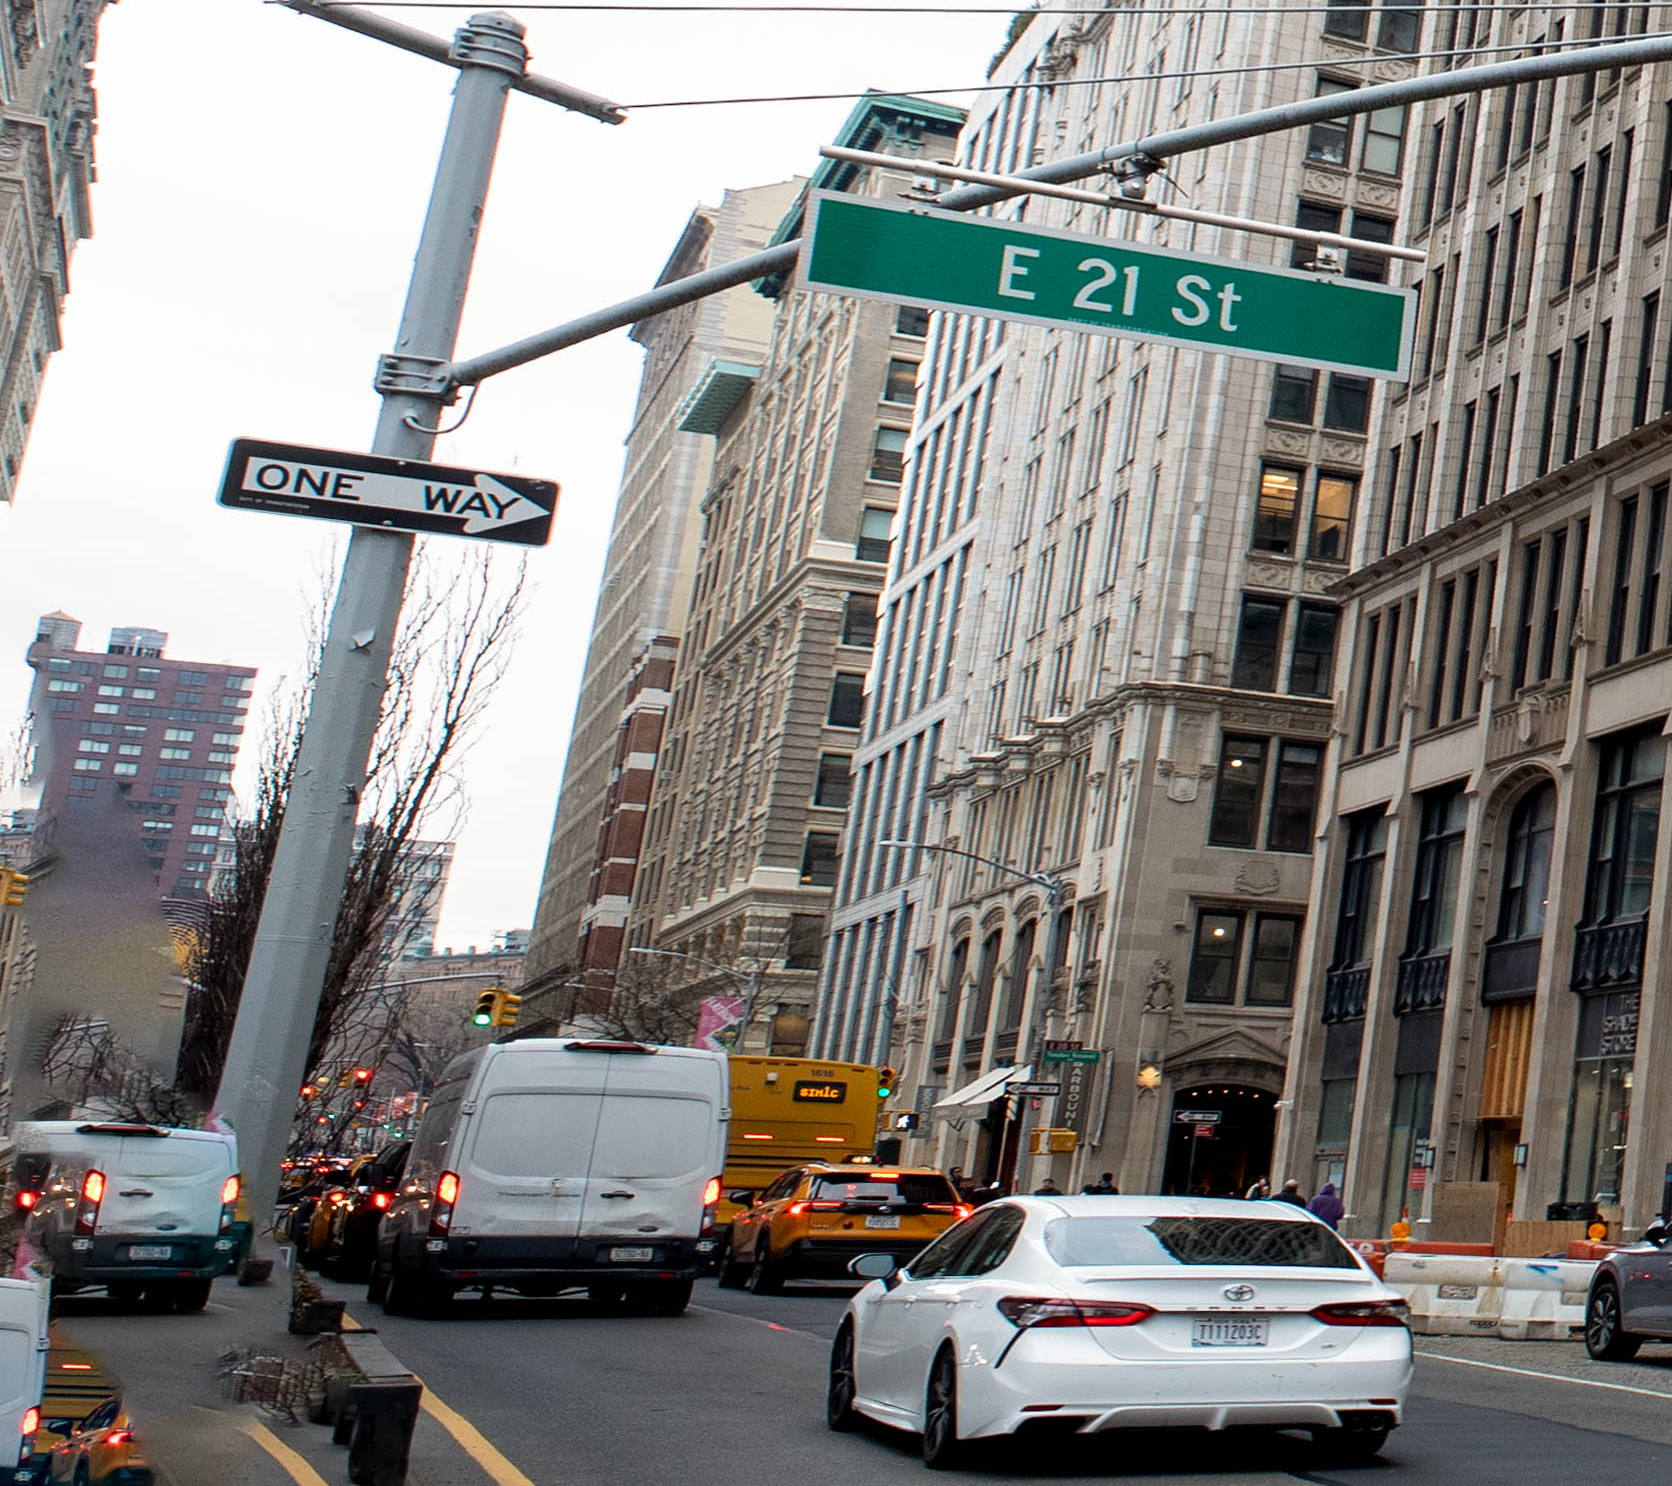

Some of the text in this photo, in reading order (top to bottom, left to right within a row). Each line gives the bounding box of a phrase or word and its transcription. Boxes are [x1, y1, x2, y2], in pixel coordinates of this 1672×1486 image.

[998, 244, 1242, 332] E 21 St
[255, 464, 522, 519] ONE WAY
